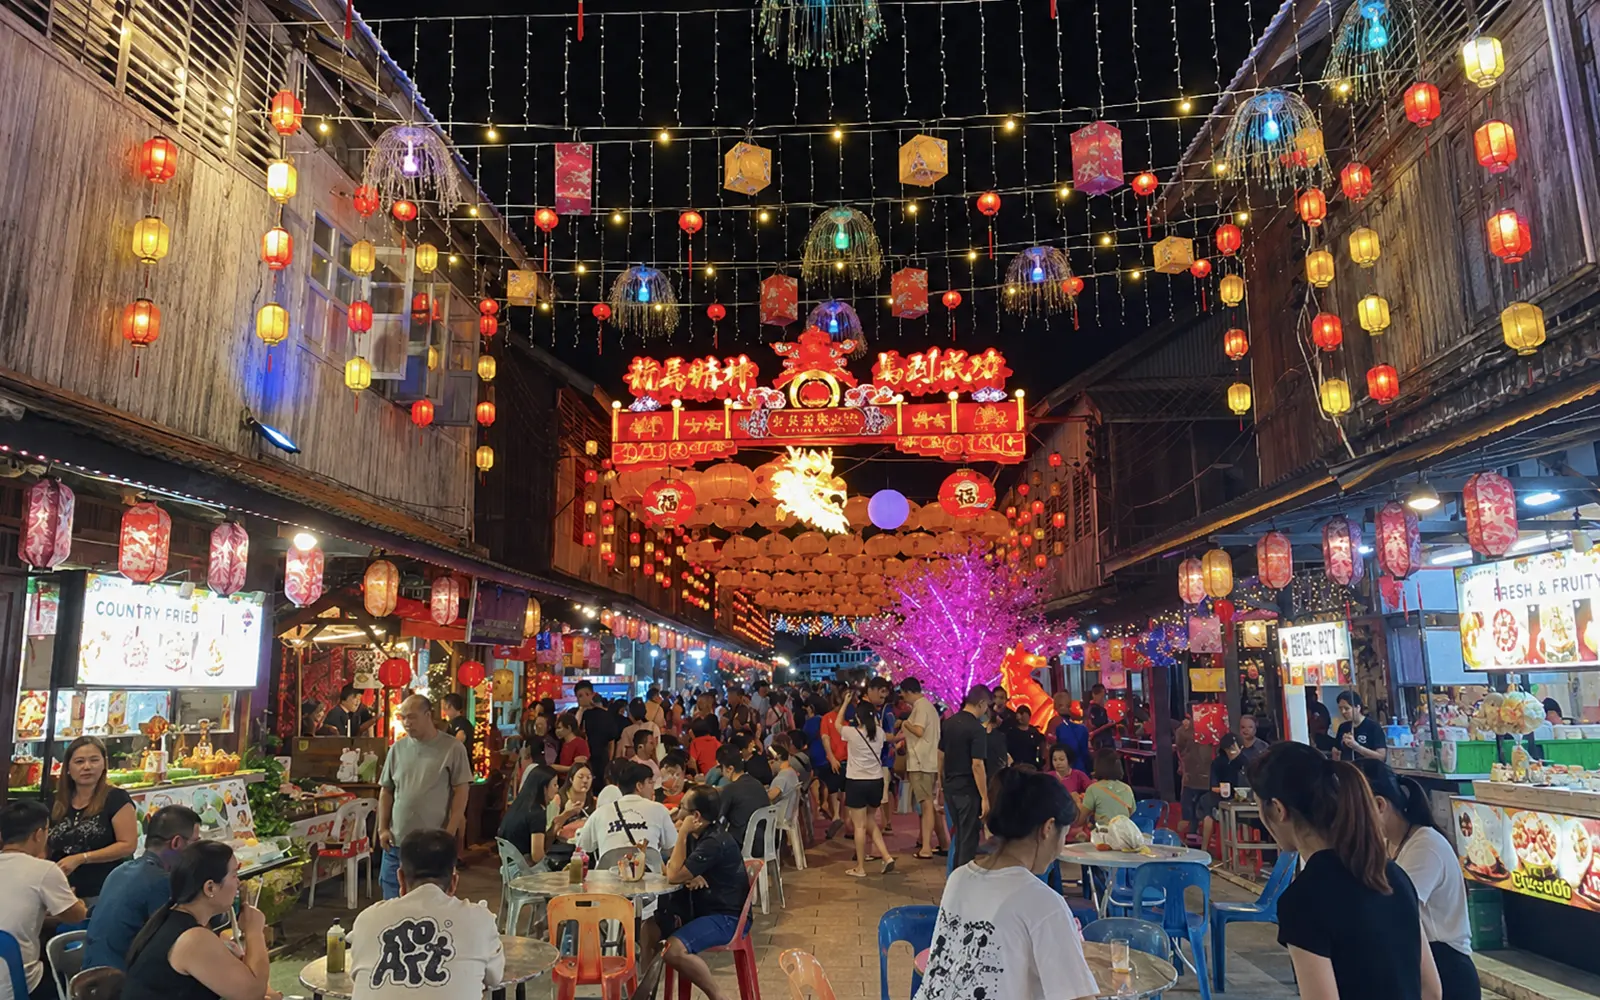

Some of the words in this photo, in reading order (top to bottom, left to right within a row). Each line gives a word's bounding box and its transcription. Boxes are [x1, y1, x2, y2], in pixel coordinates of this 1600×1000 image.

[660, 494, 677, 512] 福
[955, 487, 976, 505] 福
[1493, 583, 1532, 601] FRESH
[1538, 580, 1547, 596] &
[96, 600, 161, 621] COUNTRY
[165, 608, 198, 624] FRIED
